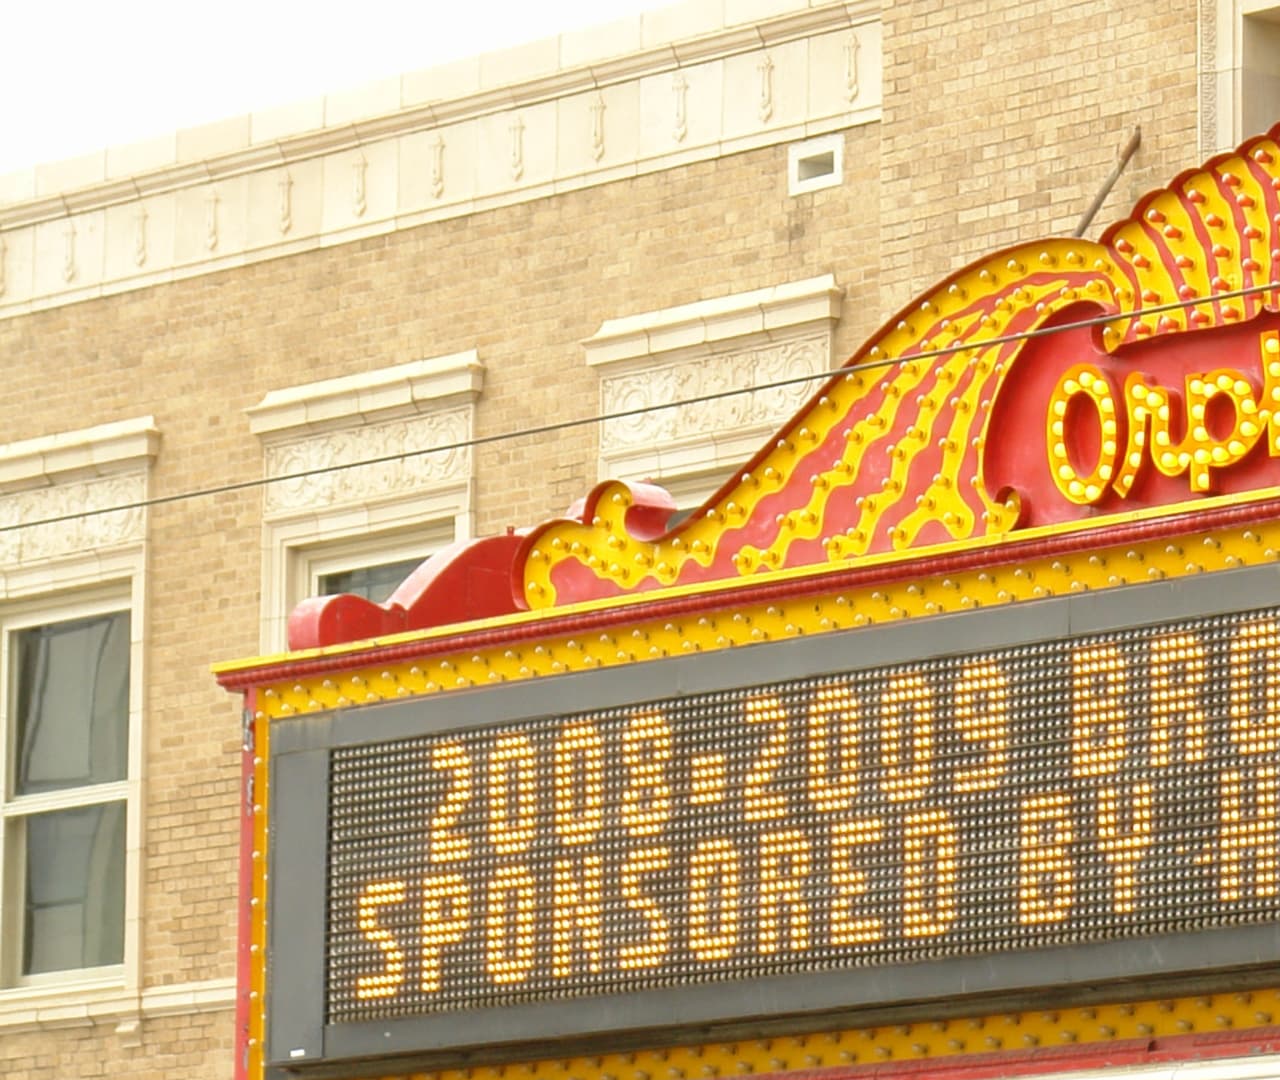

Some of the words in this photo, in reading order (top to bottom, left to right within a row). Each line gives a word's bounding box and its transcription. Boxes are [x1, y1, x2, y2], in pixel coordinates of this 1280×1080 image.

[430, 661, 1008, 861] 2008-2009
[357, 808, 958, 998] SPONSORED
[1019, 782, 1153, 925] BY
